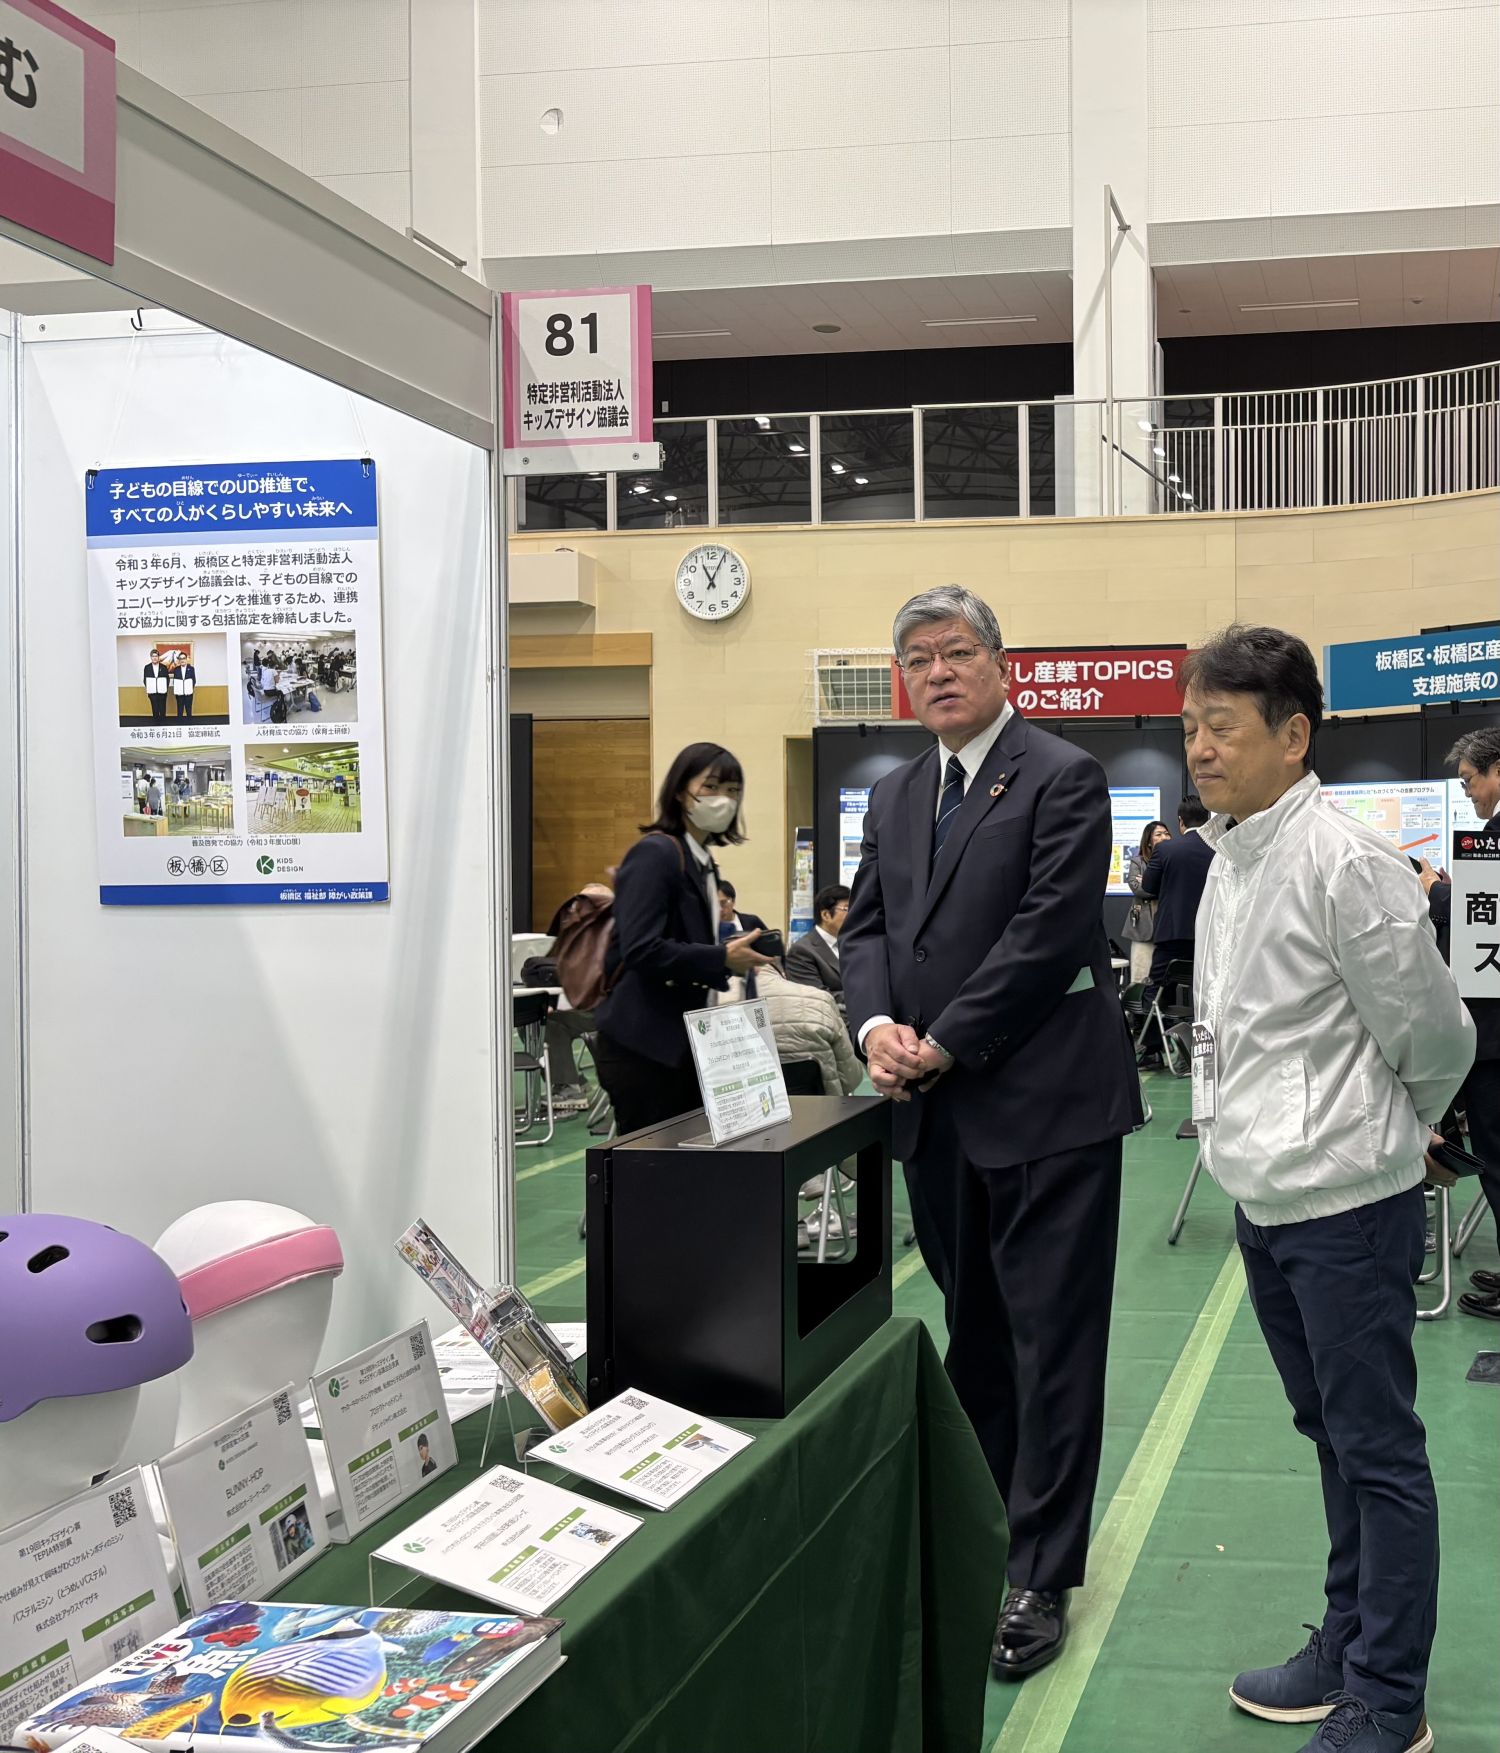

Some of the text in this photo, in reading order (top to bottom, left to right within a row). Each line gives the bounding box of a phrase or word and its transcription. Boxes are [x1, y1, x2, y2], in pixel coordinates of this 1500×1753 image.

[545, 313, 598, 356] 81
[527, 379, 624, 405] 特定非営利活動法人
[523, 405, 629, 431] キッズデザイン協議会
[109, 477, 317, 500] 子どもの目線でのUD推進で、
[110, 500, 353, 524] すべての人がくらしやすい未来へ
[706, 552, 718, 560] 12
[686, 565, 697, 574] 10
[730, 564, 738, 573] 2
[116, 572, 358, 590] キッズデザイン協議会は、子どもの目線での
[683, 578, 691, 586] 9
[734, 577, 741, 586] 3
[116, 591, 359, 609] ユニバーサルデザインを推進するため、連携
[687, 591, 695, 599] 8
[721, 600, 729, 608] 5
[696, 600, 704, 609] 7
[708, 604, 717, 612] 6
[117, 611, 352, 629] 及び協力に関する包括協定を締結しました。
[1375, 639, 1500, 671] 板橋区・板橋区産
[1008, 660, 1174, 683] し産業TOPICS
[1412, 671, 1498, 697] 支援施策の
[1017, 687, 1104, 711] のご紹介
[168, 857, 228, 875] 板橋区
[1466, 892, 1498, 925] 商
[225, 1467, 264, 1500] BUNNY-HOP
[122, 1643, 188, 1675] LIVE
